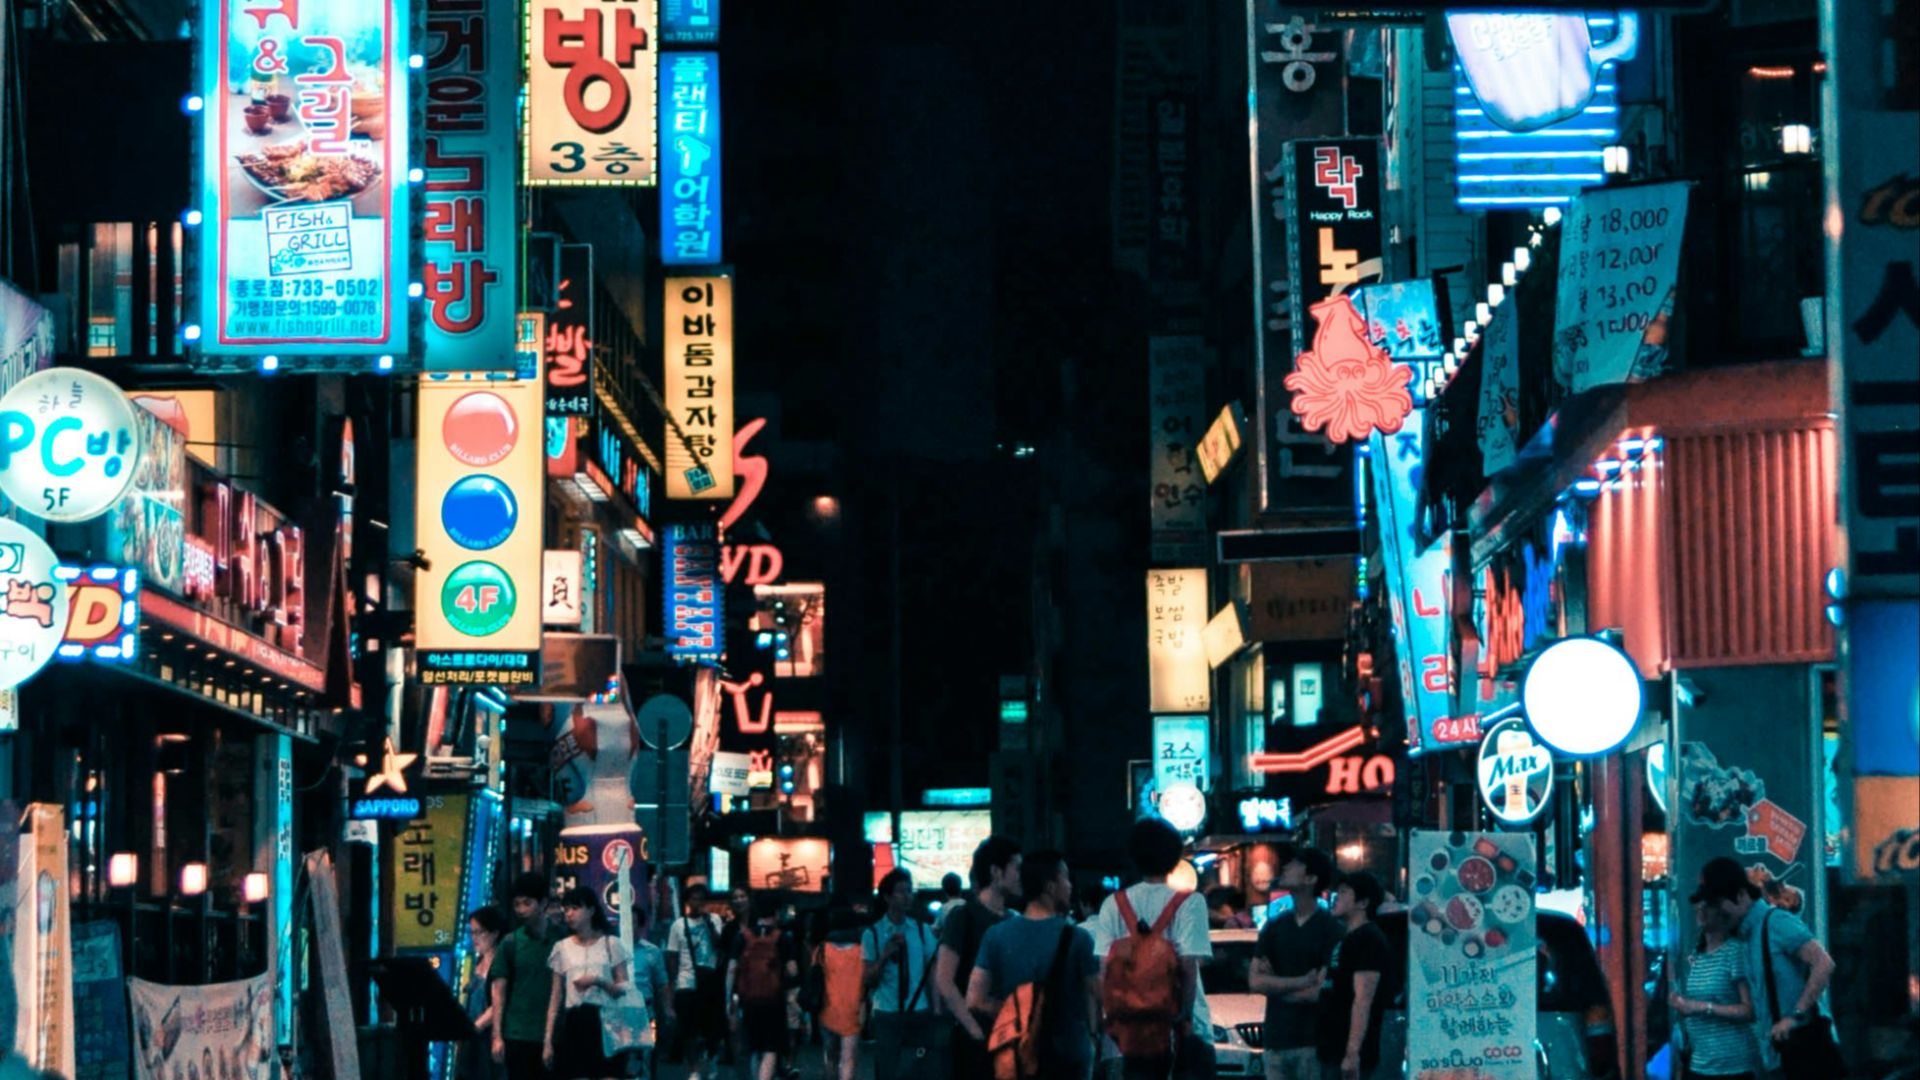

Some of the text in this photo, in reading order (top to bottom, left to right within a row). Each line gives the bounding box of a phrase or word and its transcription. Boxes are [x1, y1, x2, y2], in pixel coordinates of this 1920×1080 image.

[255, 39, 289, 75] &
[543, 8, 648, 134] 방
[295, 37, 353, 154] 그릴
[550, 142, 645, 175] 3층
[1314, 146, 1362, 209] 락
[277, 211, 325, 229] FISH
[674, 175, 711, 258] 어학원
[1310, 210, 1373, 222] Happy Rock
[1599, 207, 1669, 235] 18,000
[288, 232, 346, 252] GRILL
[236, 279, 378, 298] 종로점:733-0502
[234, 318, 375, 334] www.fishngrill.net
[682, 282, 717, 459] 이바돔감자탕
[0, 411, 131, 478] PC방
[43, 487, 70, 511] 5F
[674, 525, 713, 541] BAR
[455, 584, 501, 613] 4F
[1436, 717, 1484, 740] 24시
[1161, 742, 1196, 759] 죠스
[1488, 755, 1537, 789] Max
[354, 798, 420, 814] SAPPORO
[555, 844, 589, 864] lus
